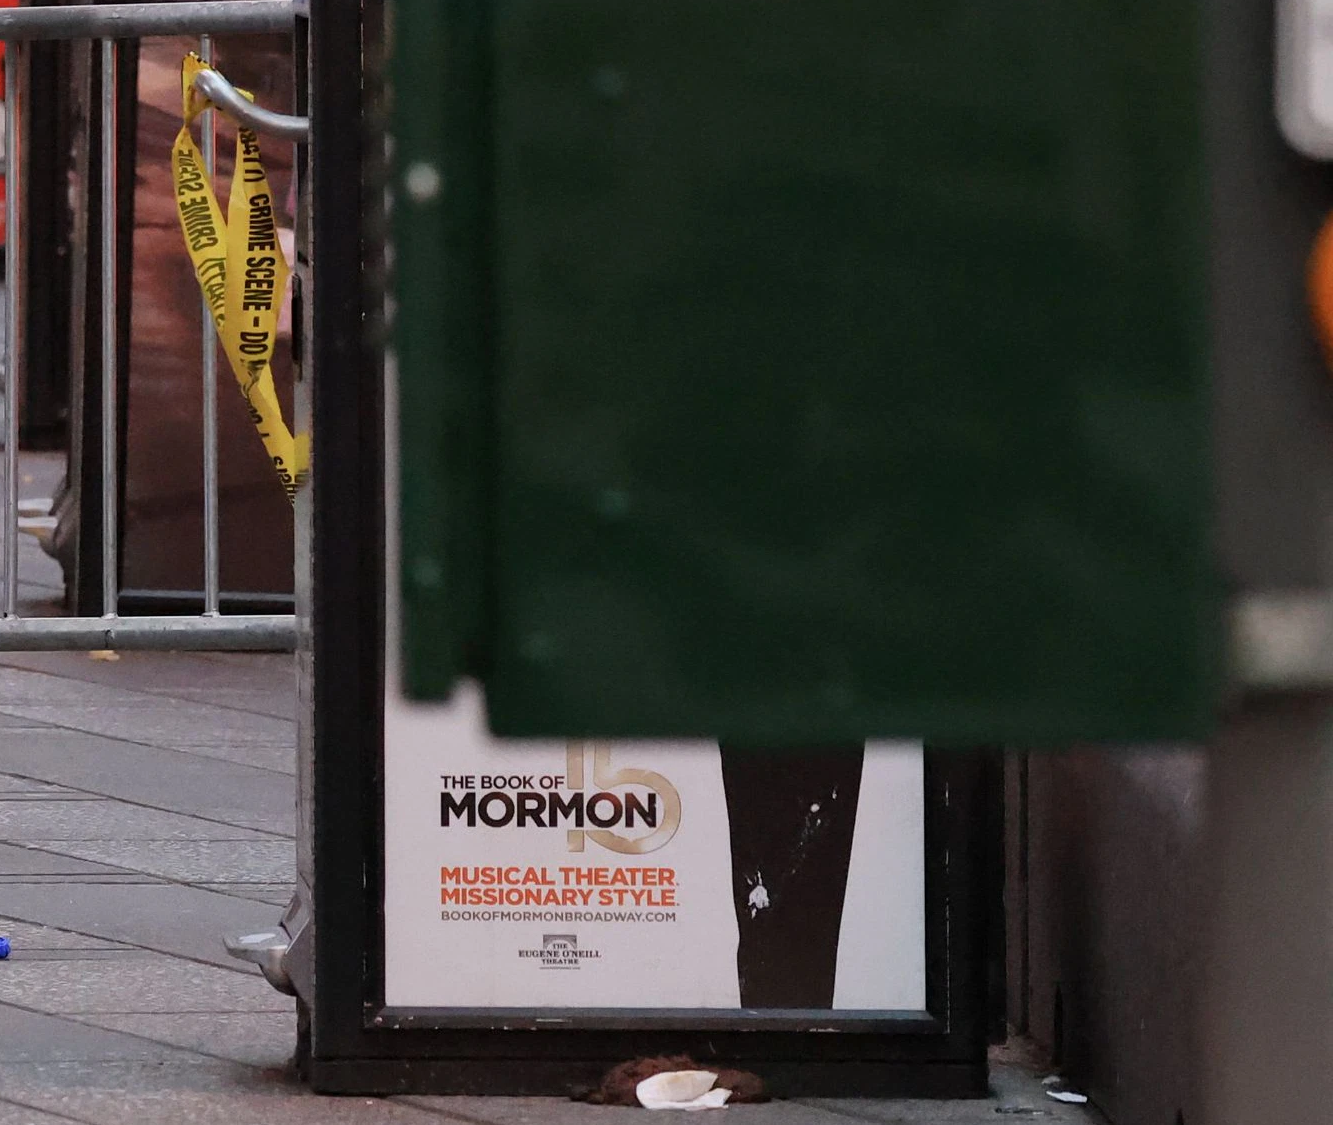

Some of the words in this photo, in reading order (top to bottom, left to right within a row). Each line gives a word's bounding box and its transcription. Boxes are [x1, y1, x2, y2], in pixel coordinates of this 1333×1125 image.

[247, 193, 275, 252] CRIME
[242, 256, 276, 311] SCENE
[239, 331, 269, 355] DO
[440, 775, 475, 789] THE
[481, 775, 534, 789] BOOK
[539, 775, 565, 789] OF
[440, 791, 657, 828] MORMON
[441, 866, 556, 886] MUSICAL
[559, 866, 680, 887] THEATER.
[441, 888, 594, 906] MISSIONARY
[598, 888, 680, 907] STYLE.
[441, 910, 676, 923] BOOKOFMORMONBROADWAY.COM
[518, 949, 560, 958] EUGENE
[562, 949, 602, 958] O'NEILL
